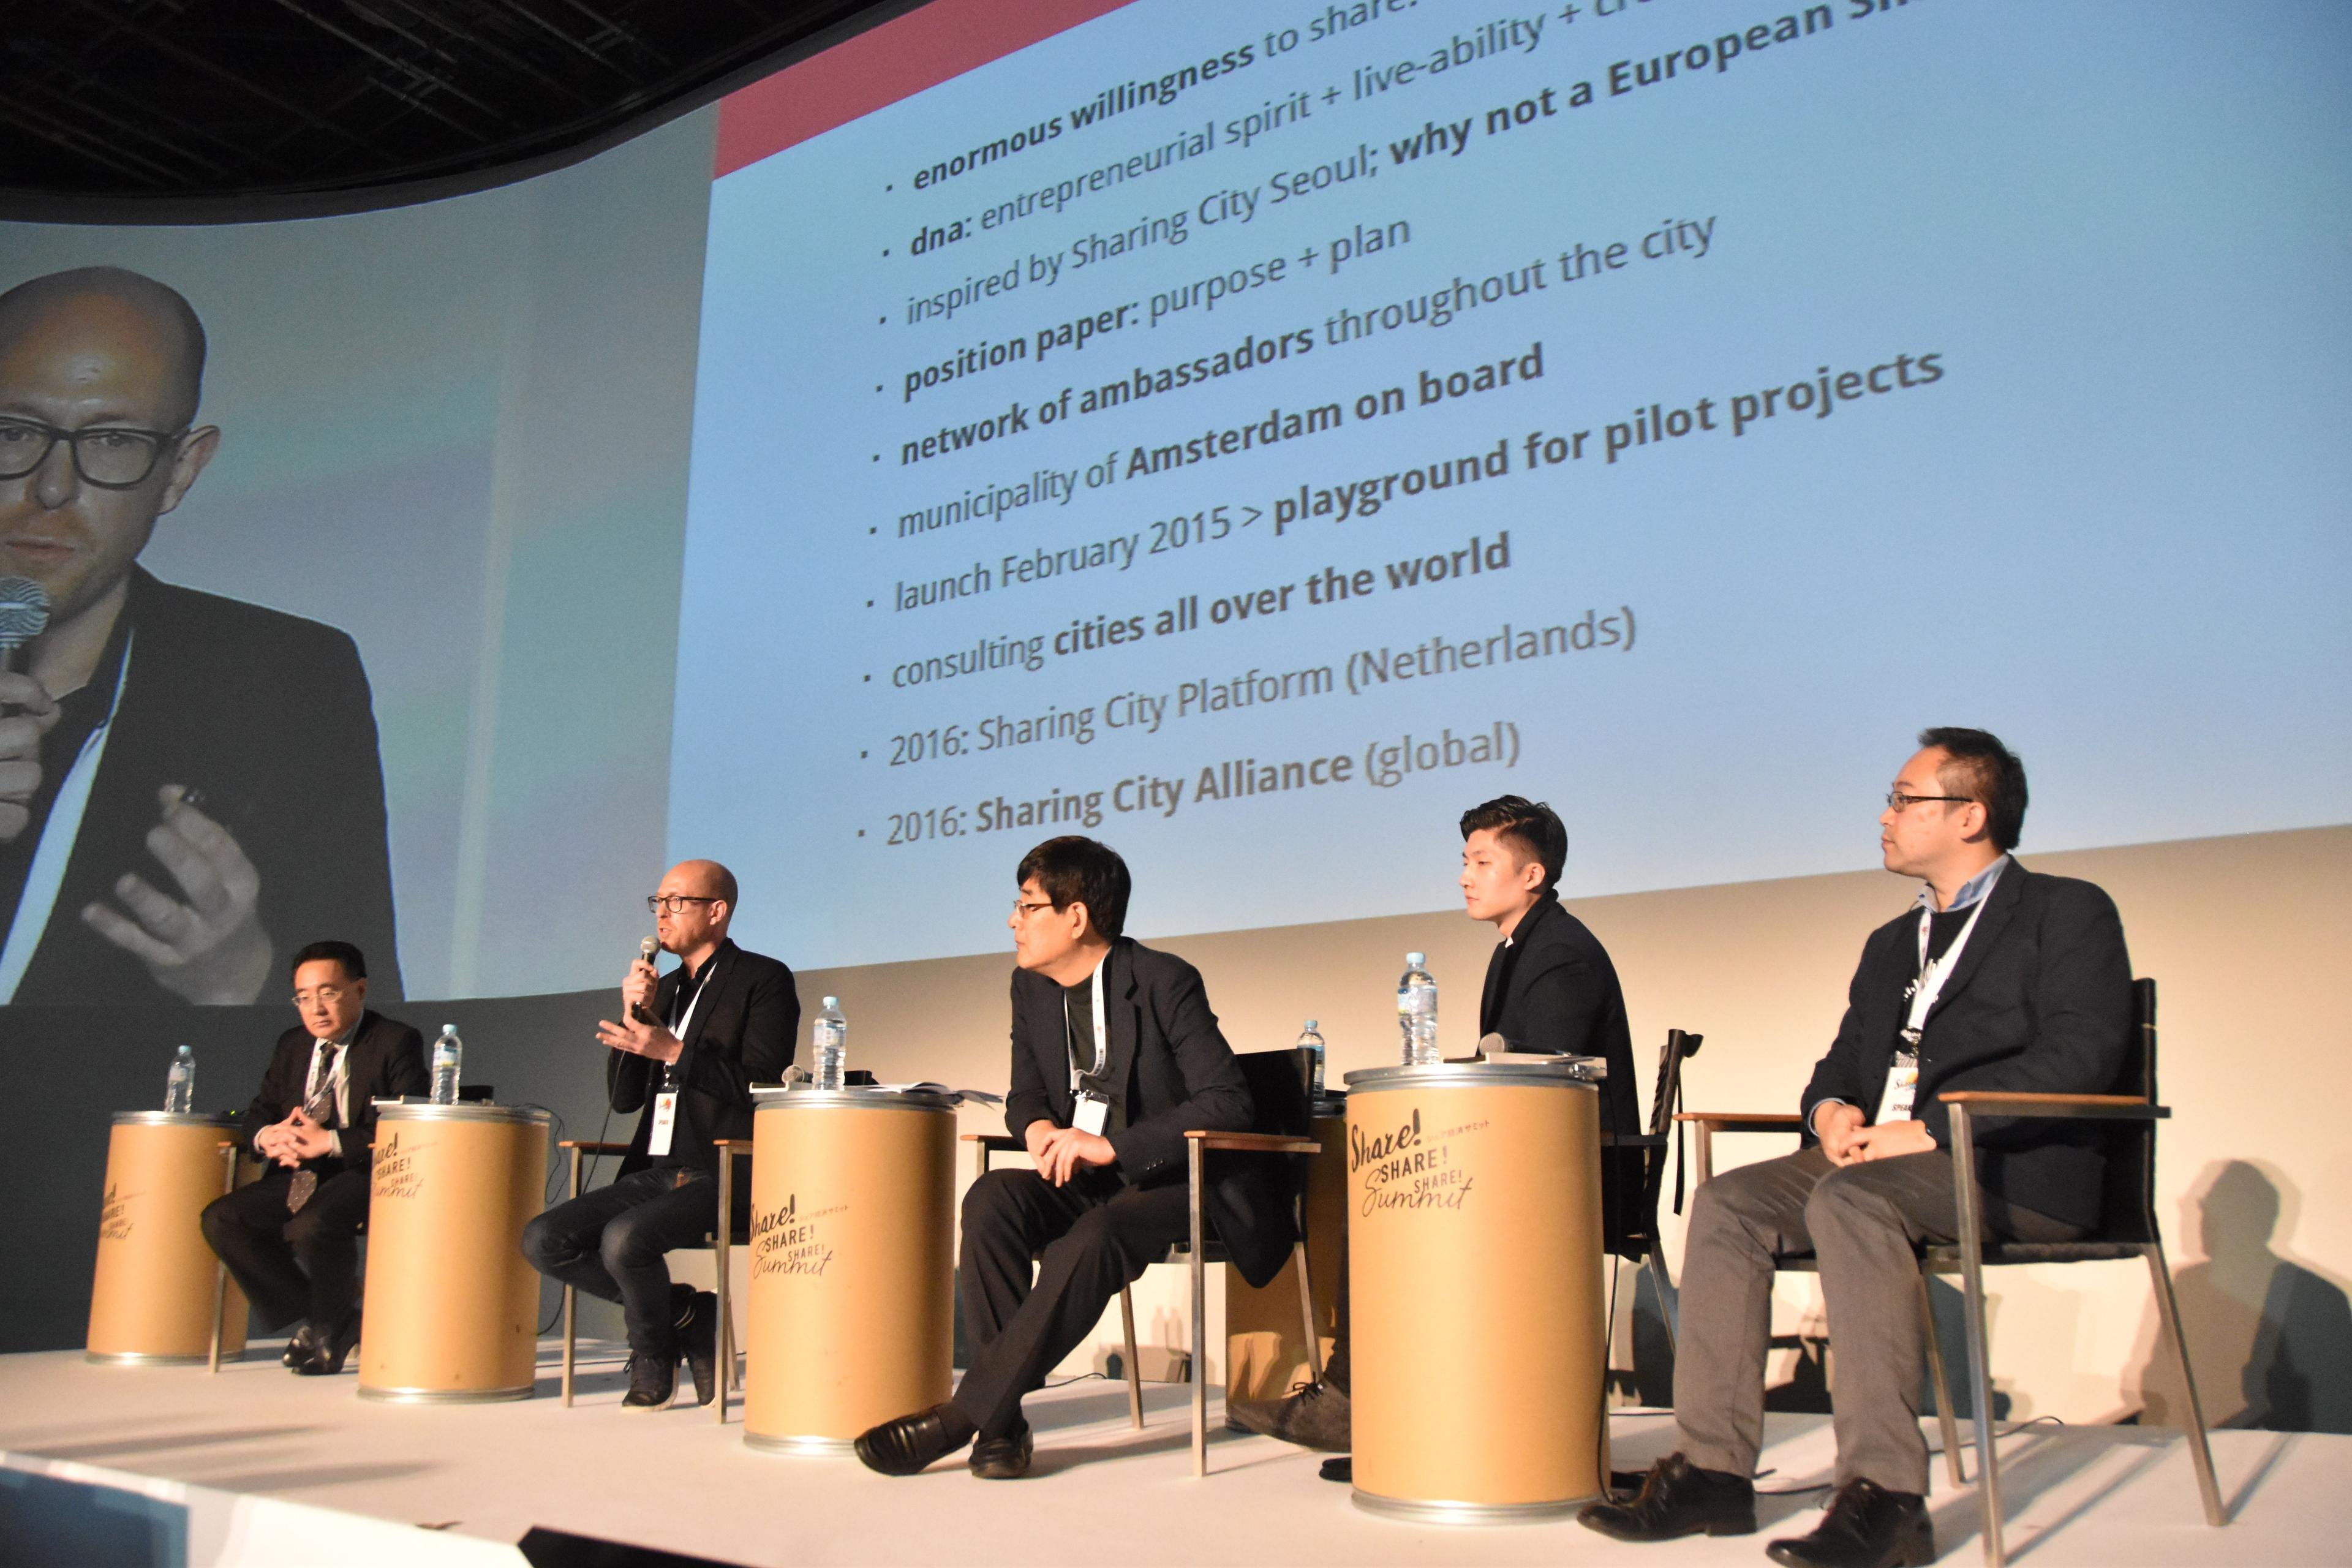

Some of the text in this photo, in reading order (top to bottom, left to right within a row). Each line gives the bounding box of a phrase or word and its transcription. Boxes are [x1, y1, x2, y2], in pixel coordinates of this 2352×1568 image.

[908, 259, 1019, 325] inspired
[1029, 248, 1065, 286] by
[1072, 211, 1188, 268] Sharing
[1199, 187, 1261, 225] City
[1270, 143, 1378, 203] Seoul;
[1389, 118, 1473, 165] why
[1486, 88, 1558, 135] not
[1569, 81, 1594, 108] a
[1608, 4, 1833, 97] European
[911, 217, 972, 257] dna:
[981, 121, 1214, 230] entrepreneurial
[1226, 92, 1311, 148] spirit
[1354, 13, 1546, 100] live-ability
[914, 117, 1063, 190] enormous
[1070, 45, 1255, 130] willingness
[1264, 29, 1298, 58] to
[902, 216, 1716, 466] network of ambassadors throughout the city
[905, 337, 1027, 403] position
[1036, 302, 1139, 362] paper:
[1151, 258, 1286, 328] purpose
[1330, 221, 1410, 274] plan
[896, 562, 991, 612] launch
[1002, 533, 1139, 587] February
[1149, 505, 1231, 554] 2015
[1275, 439, 1509, 537] playground
[1523, 430, 1591, 469] for
[1605, 398, 1718, 464] pilot
[1731, 353, 1945, 437] projects
[898, 341, 1544, 538] municipality of Amsterdam on board
[890, 606, 1636, 766] 2016: Sharing City Platform (Netherlands)
[893, 530, 1511, 688] consulting cities all over the world
[887, 721, 1520, 845] 2016: Sharing City Alliance (global)
[1352, 1109, 1422, 1172] Share!
[1362, 1169, 1473, 1217] Summit
[1381, 1146, 1448, 1183] SHARE!
[1414, 1170, 1462, 1194] SHARE!
[754, 1240, 832, 1279] Summit
[766, 1224, 814, 1253] SHARE!
[788, 1244, 824, 1262] SHARE!
